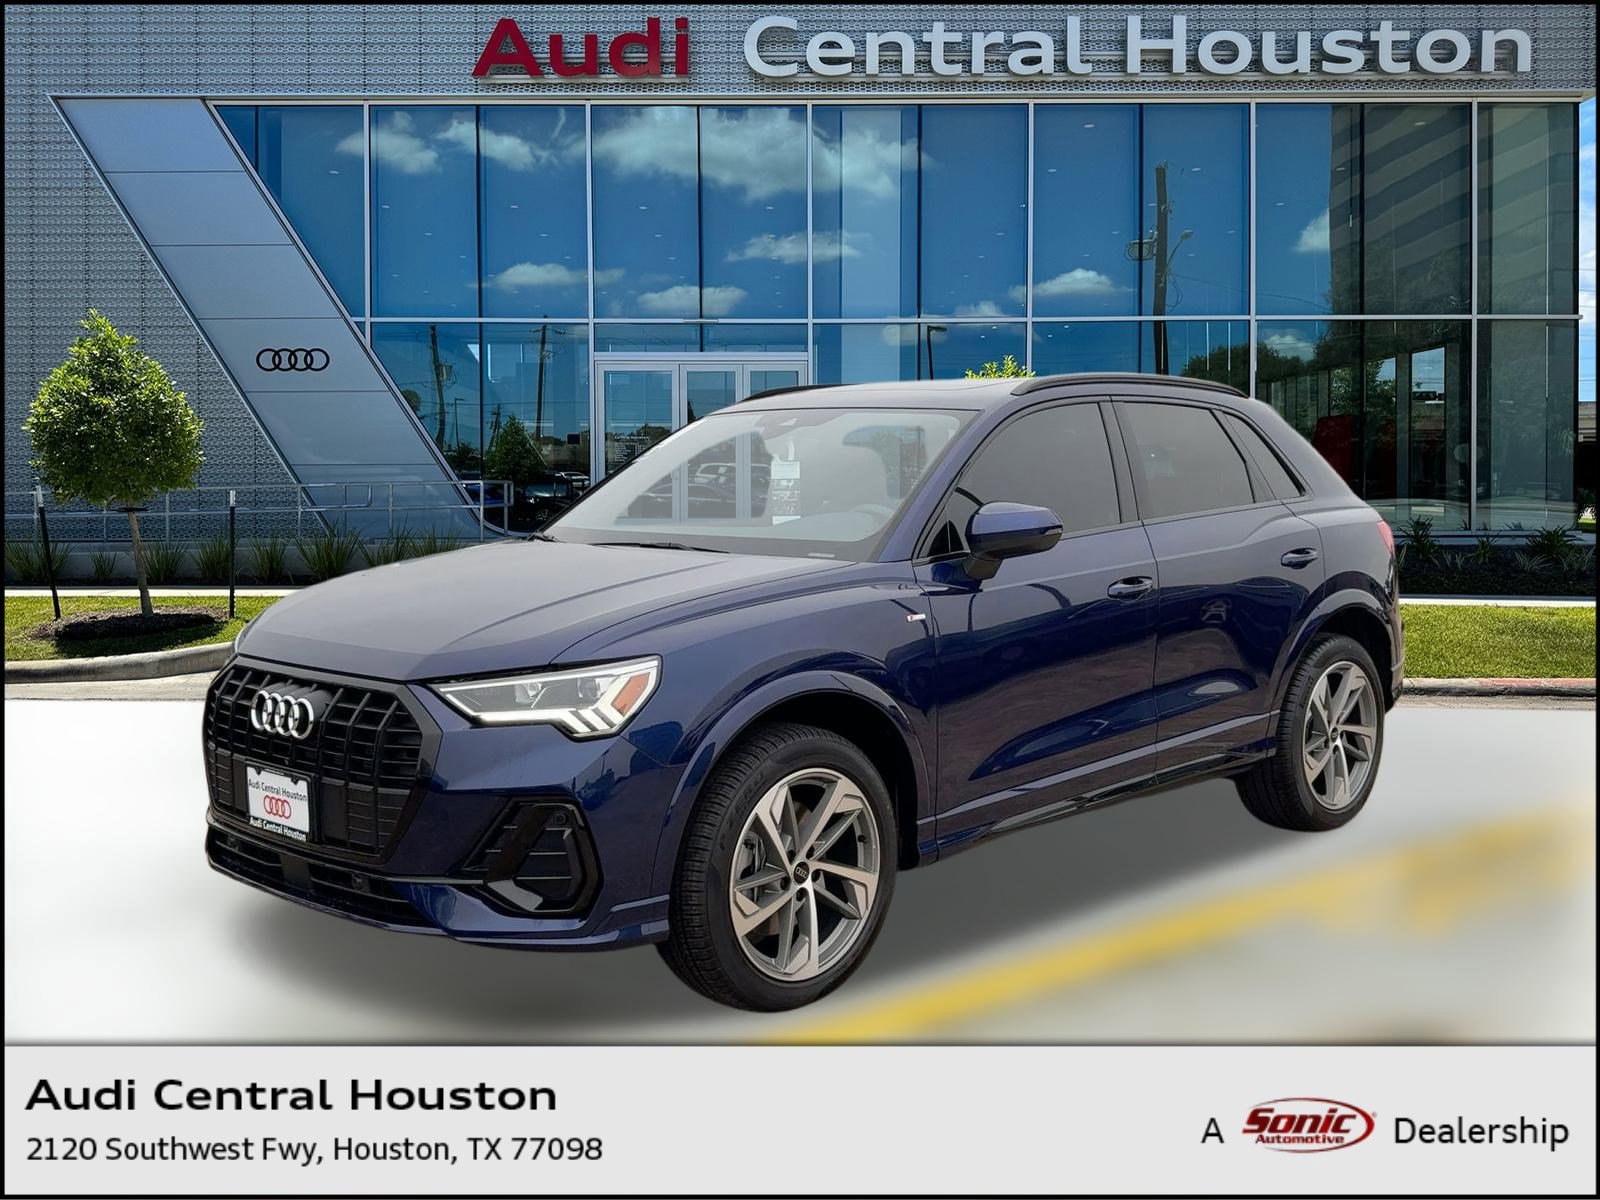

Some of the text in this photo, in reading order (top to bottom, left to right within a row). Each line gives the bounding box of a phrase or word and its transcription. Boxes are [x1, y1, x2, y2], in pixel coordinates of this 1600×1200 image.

[471, 14, 1532, 78] Audi Central Houston
[249, 778, 308, 801] Audi Central Houston
[249, 816, 306, 842] Audi Central Houston
